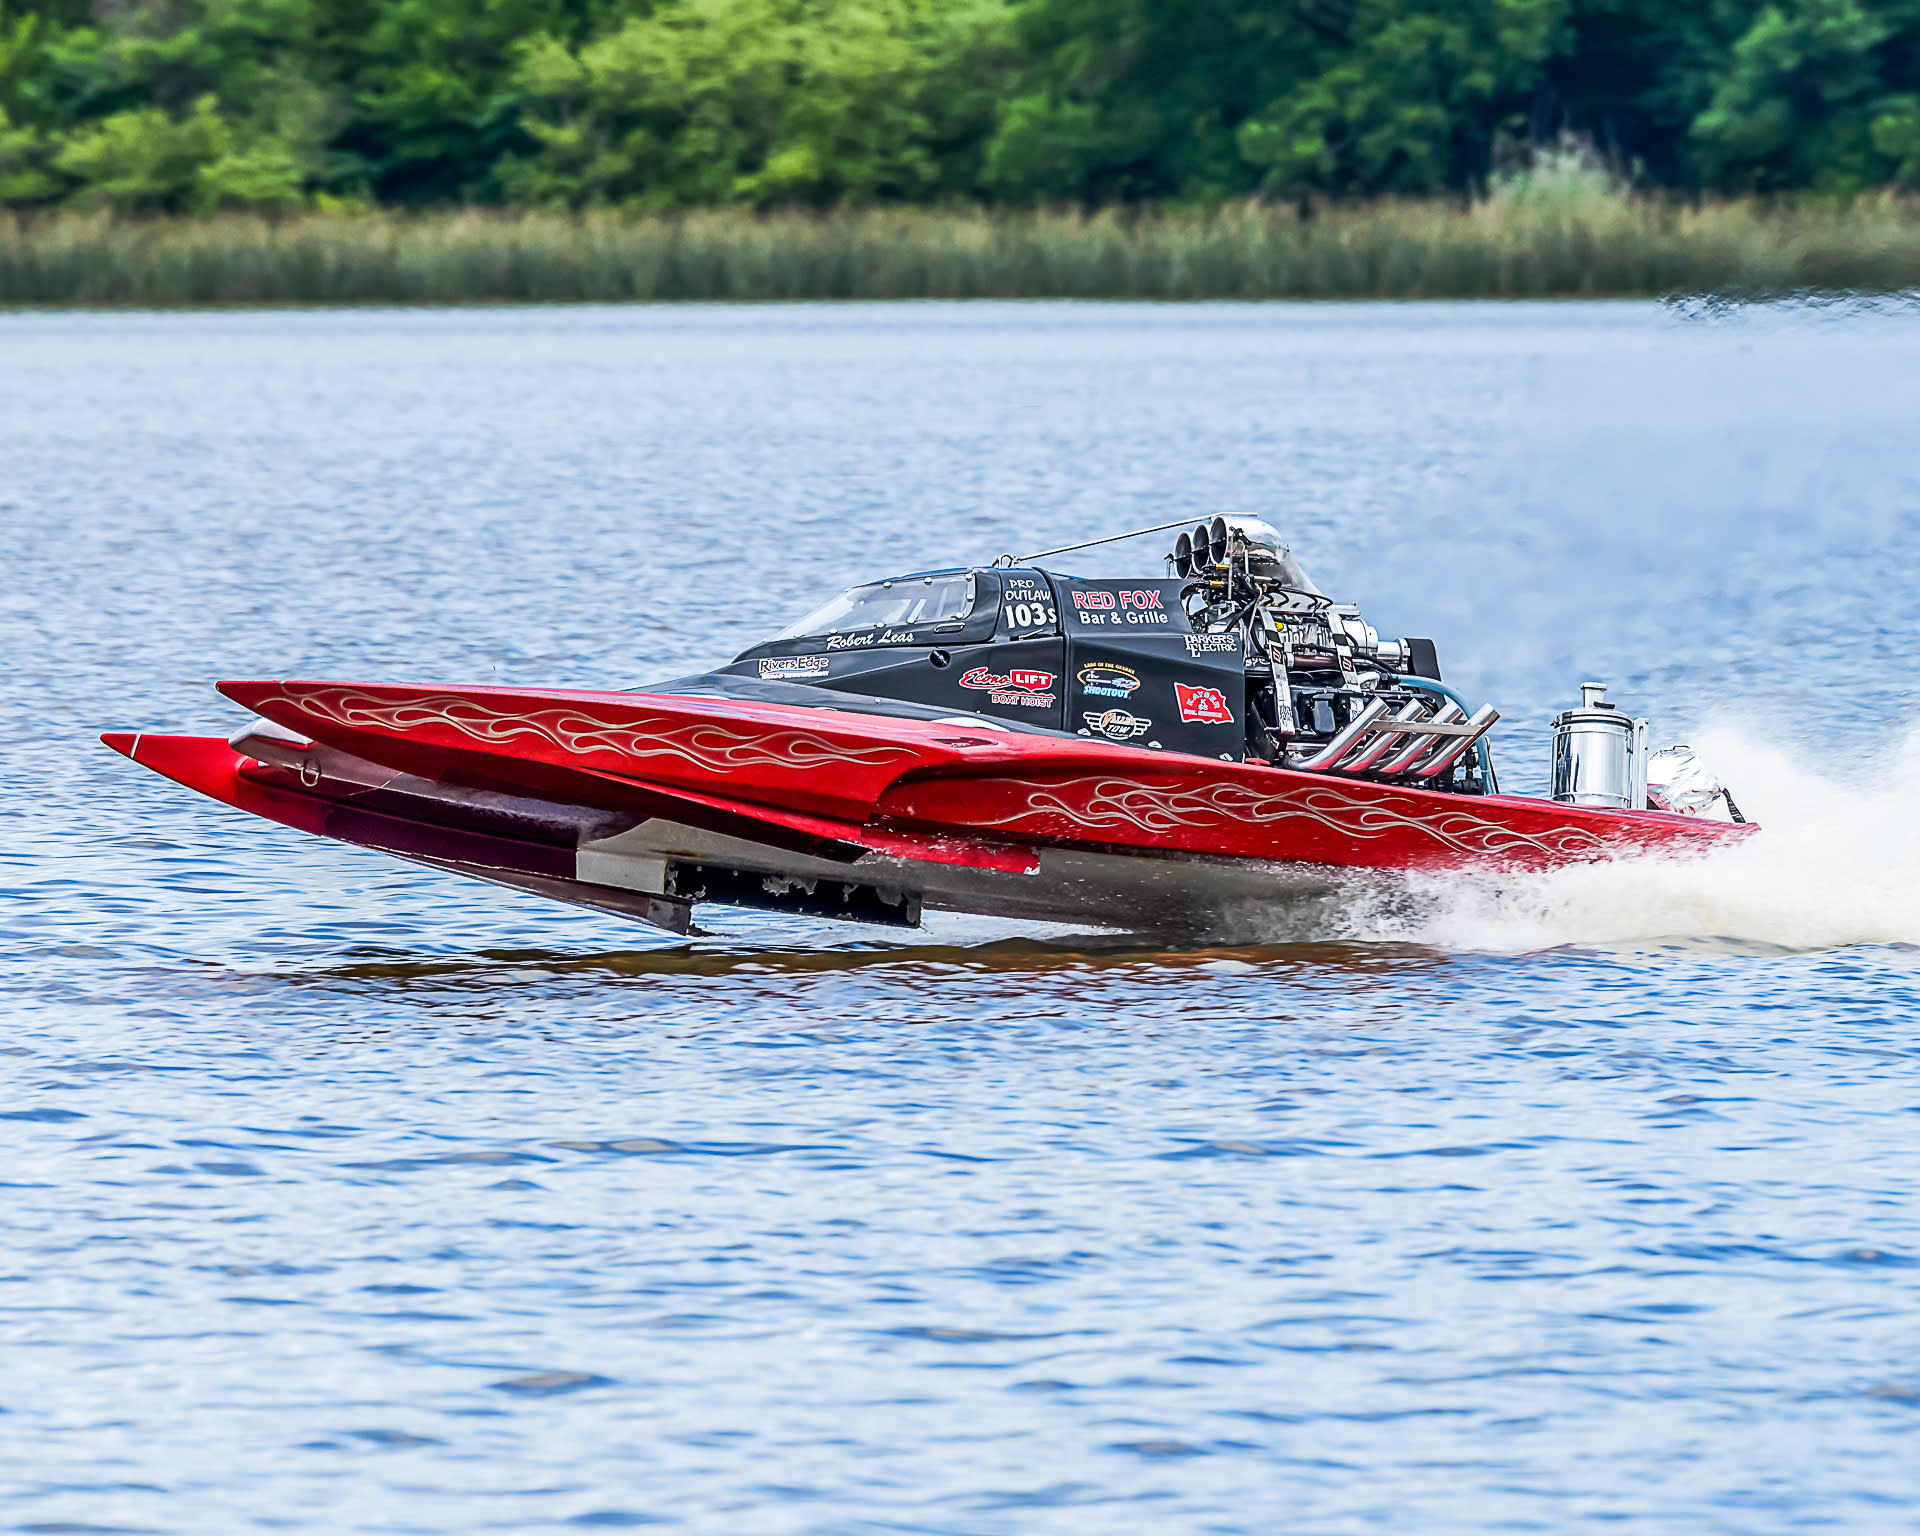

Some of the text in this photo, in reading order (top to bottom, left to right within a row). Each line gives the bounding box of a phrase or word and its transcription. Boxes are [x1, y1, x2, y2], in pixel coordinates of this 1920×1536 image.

[1009, 579, 1035, 589] PRO
[1005, 589, 1051, 602] OUTLAW
[1072, 589, 1165, 610] RED FOX
[1079, 611, 1169, 625] Bar & Grille
[827, 629, 914, 650] Robert Leas
[1190, 643, 1238, 658] ELECTRIC
[797, 656, 830, 671] Edge
[959, 666, 1050, 690] Econo LIFT
[1083, 685, 1131, 699] SHOOTOUT
[991, 695, 1053, 708] BOAT HOIST
[1106, 724, 1131, 734] TOW
